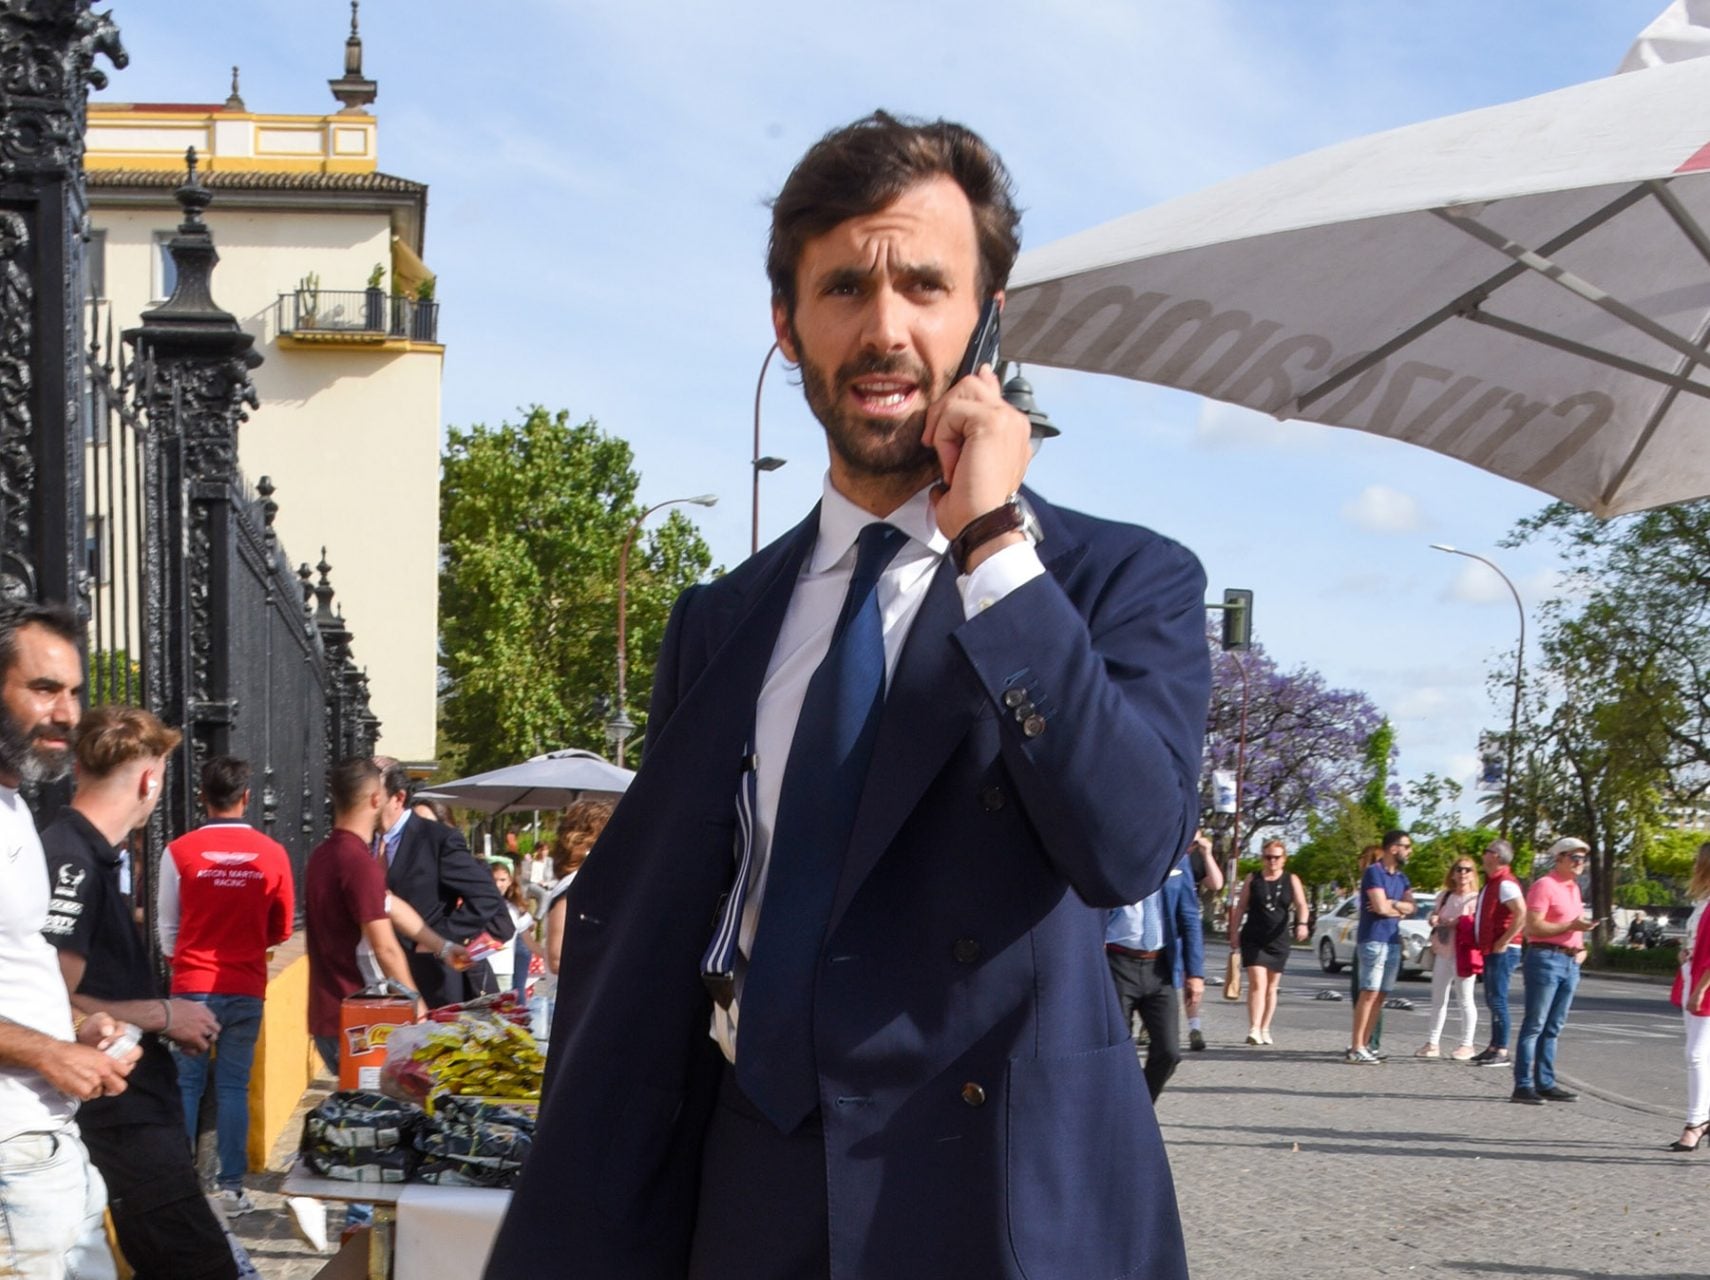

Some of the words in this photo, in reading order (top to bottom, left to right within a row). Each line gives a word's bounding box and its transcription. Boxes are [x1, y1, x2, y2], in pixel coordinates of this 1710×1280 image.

[196, 869, 227, 878] ASTON
[228, 869, 265, 880] MARTIN
[213, 878, 247, 888] RACING
